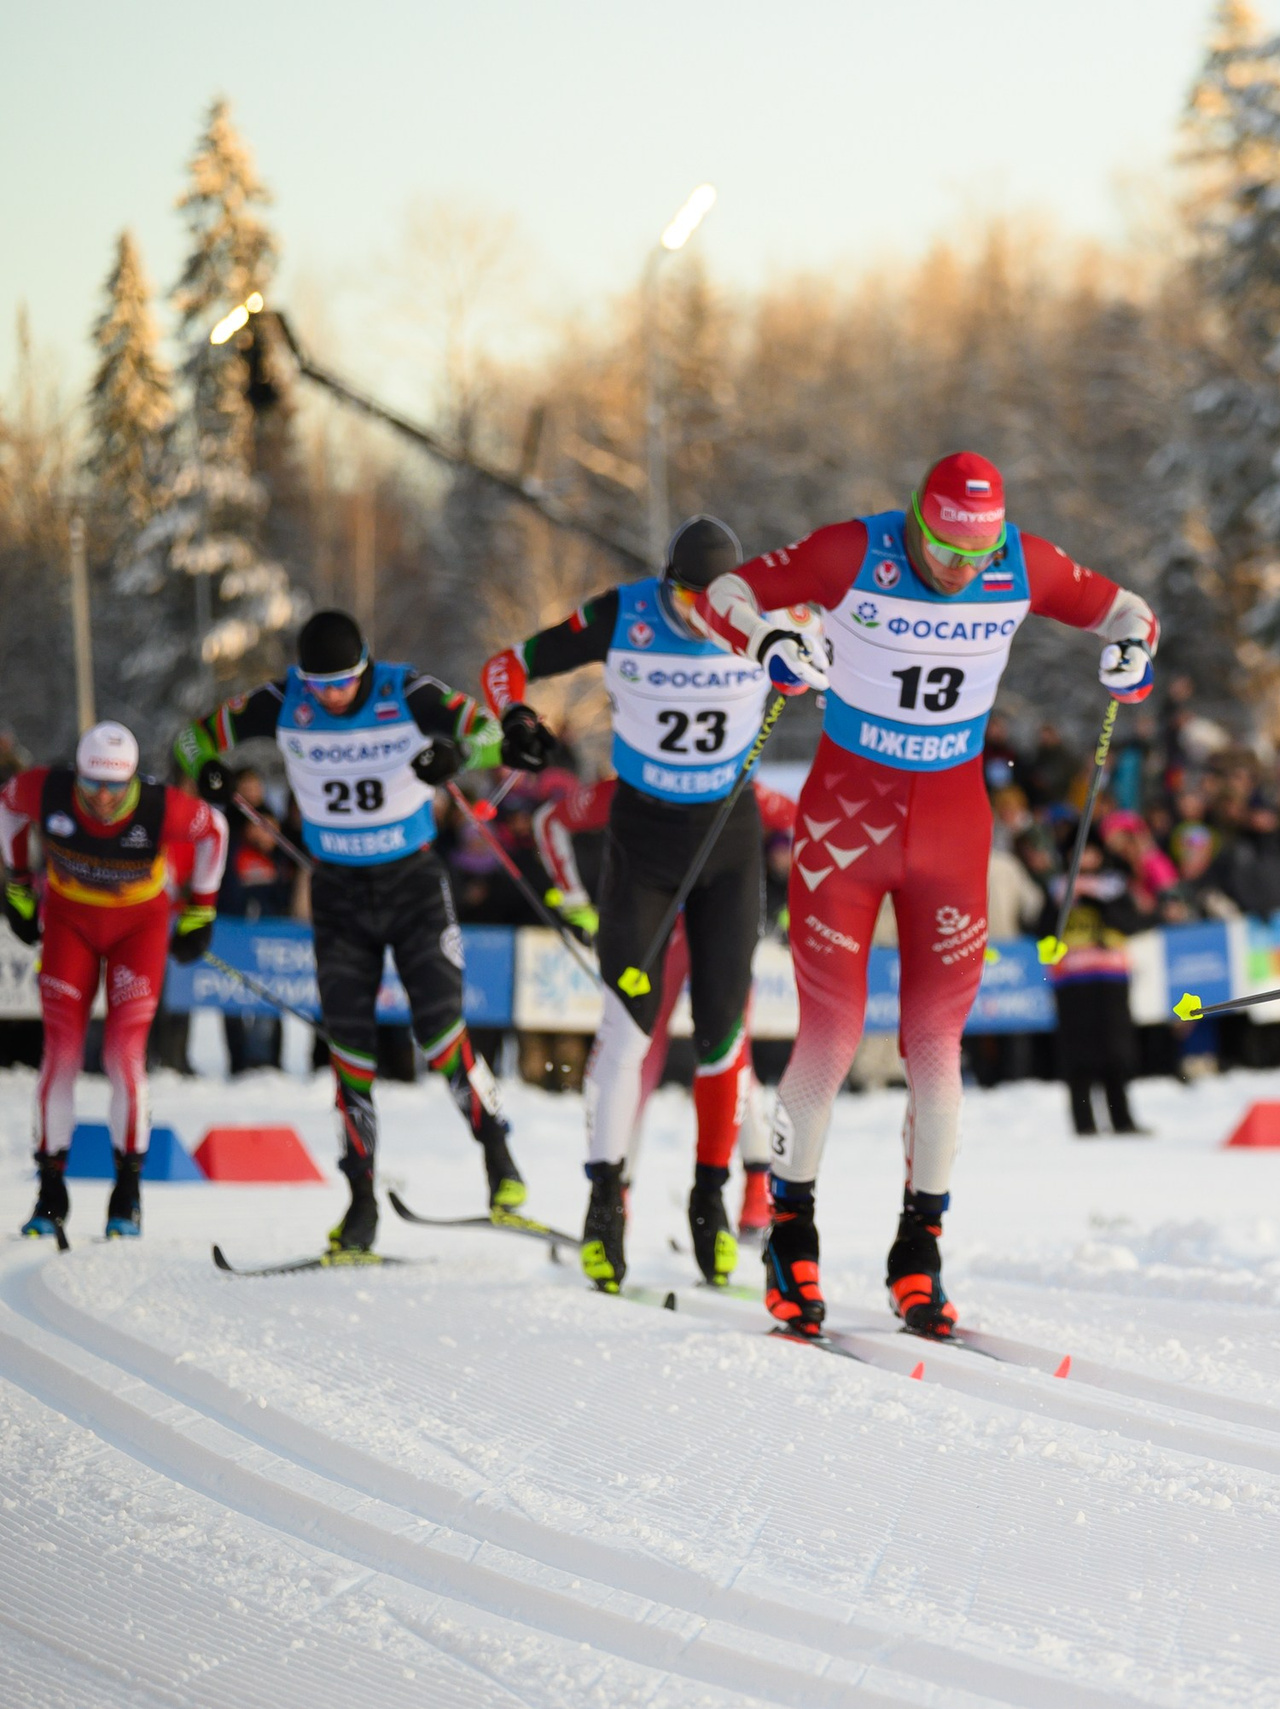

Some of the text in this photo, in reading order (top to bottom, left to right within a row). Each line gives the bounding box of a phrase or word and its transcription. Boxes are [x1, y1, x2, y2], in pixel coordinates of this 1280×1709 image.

[891, 665, 965, 712] 13
[657, 710, 728, 753] 23
[859, 721, 971, 761] ИЖЕВСК
[310, 738, 411, 762] ФОСАГРО
[324, 779, 384, 812] 28
[642, 761, 738, 794] ИЖЕВСК
